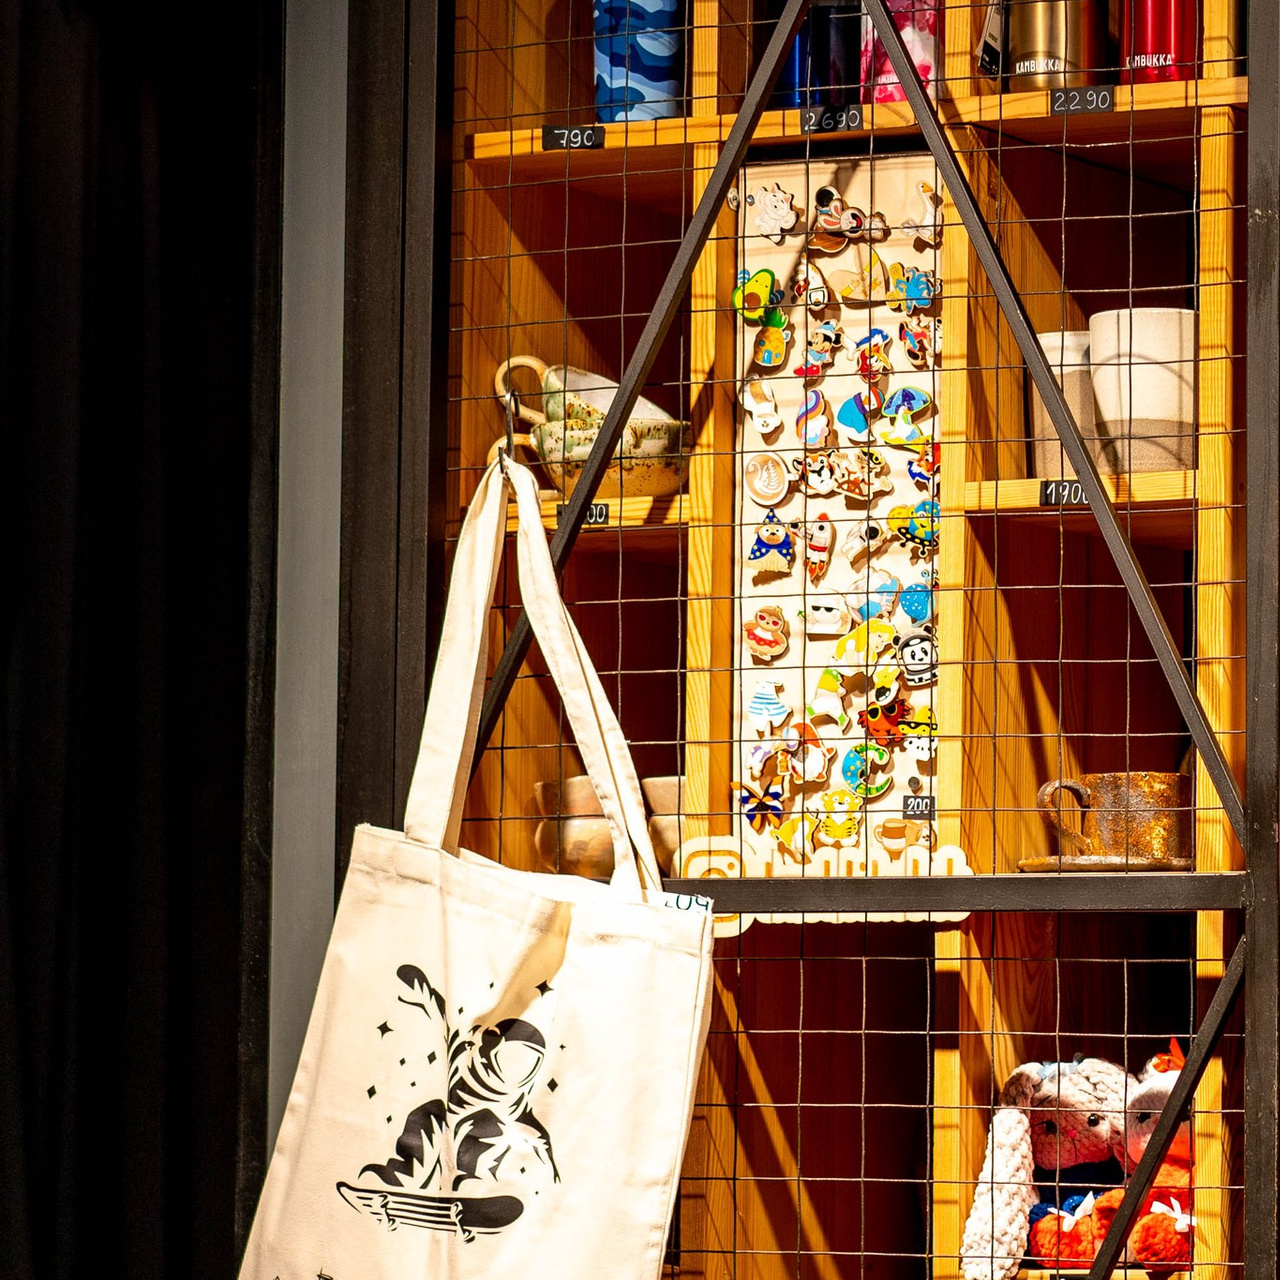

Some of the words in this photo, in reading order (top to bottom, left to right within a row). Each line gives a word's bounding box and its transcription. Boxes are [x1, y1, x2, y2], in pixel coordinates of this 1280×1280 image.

[1015, 59, 1060, 74] KAMBUKKA
[1126, 54, 1173, 69] KAMBUKKA
[1054, 91, 1110, 110] 2290
[805, 110, 860, 130] 2690
[554, 129, 595, 147] 790
[905, 797, 930, 815] 200
